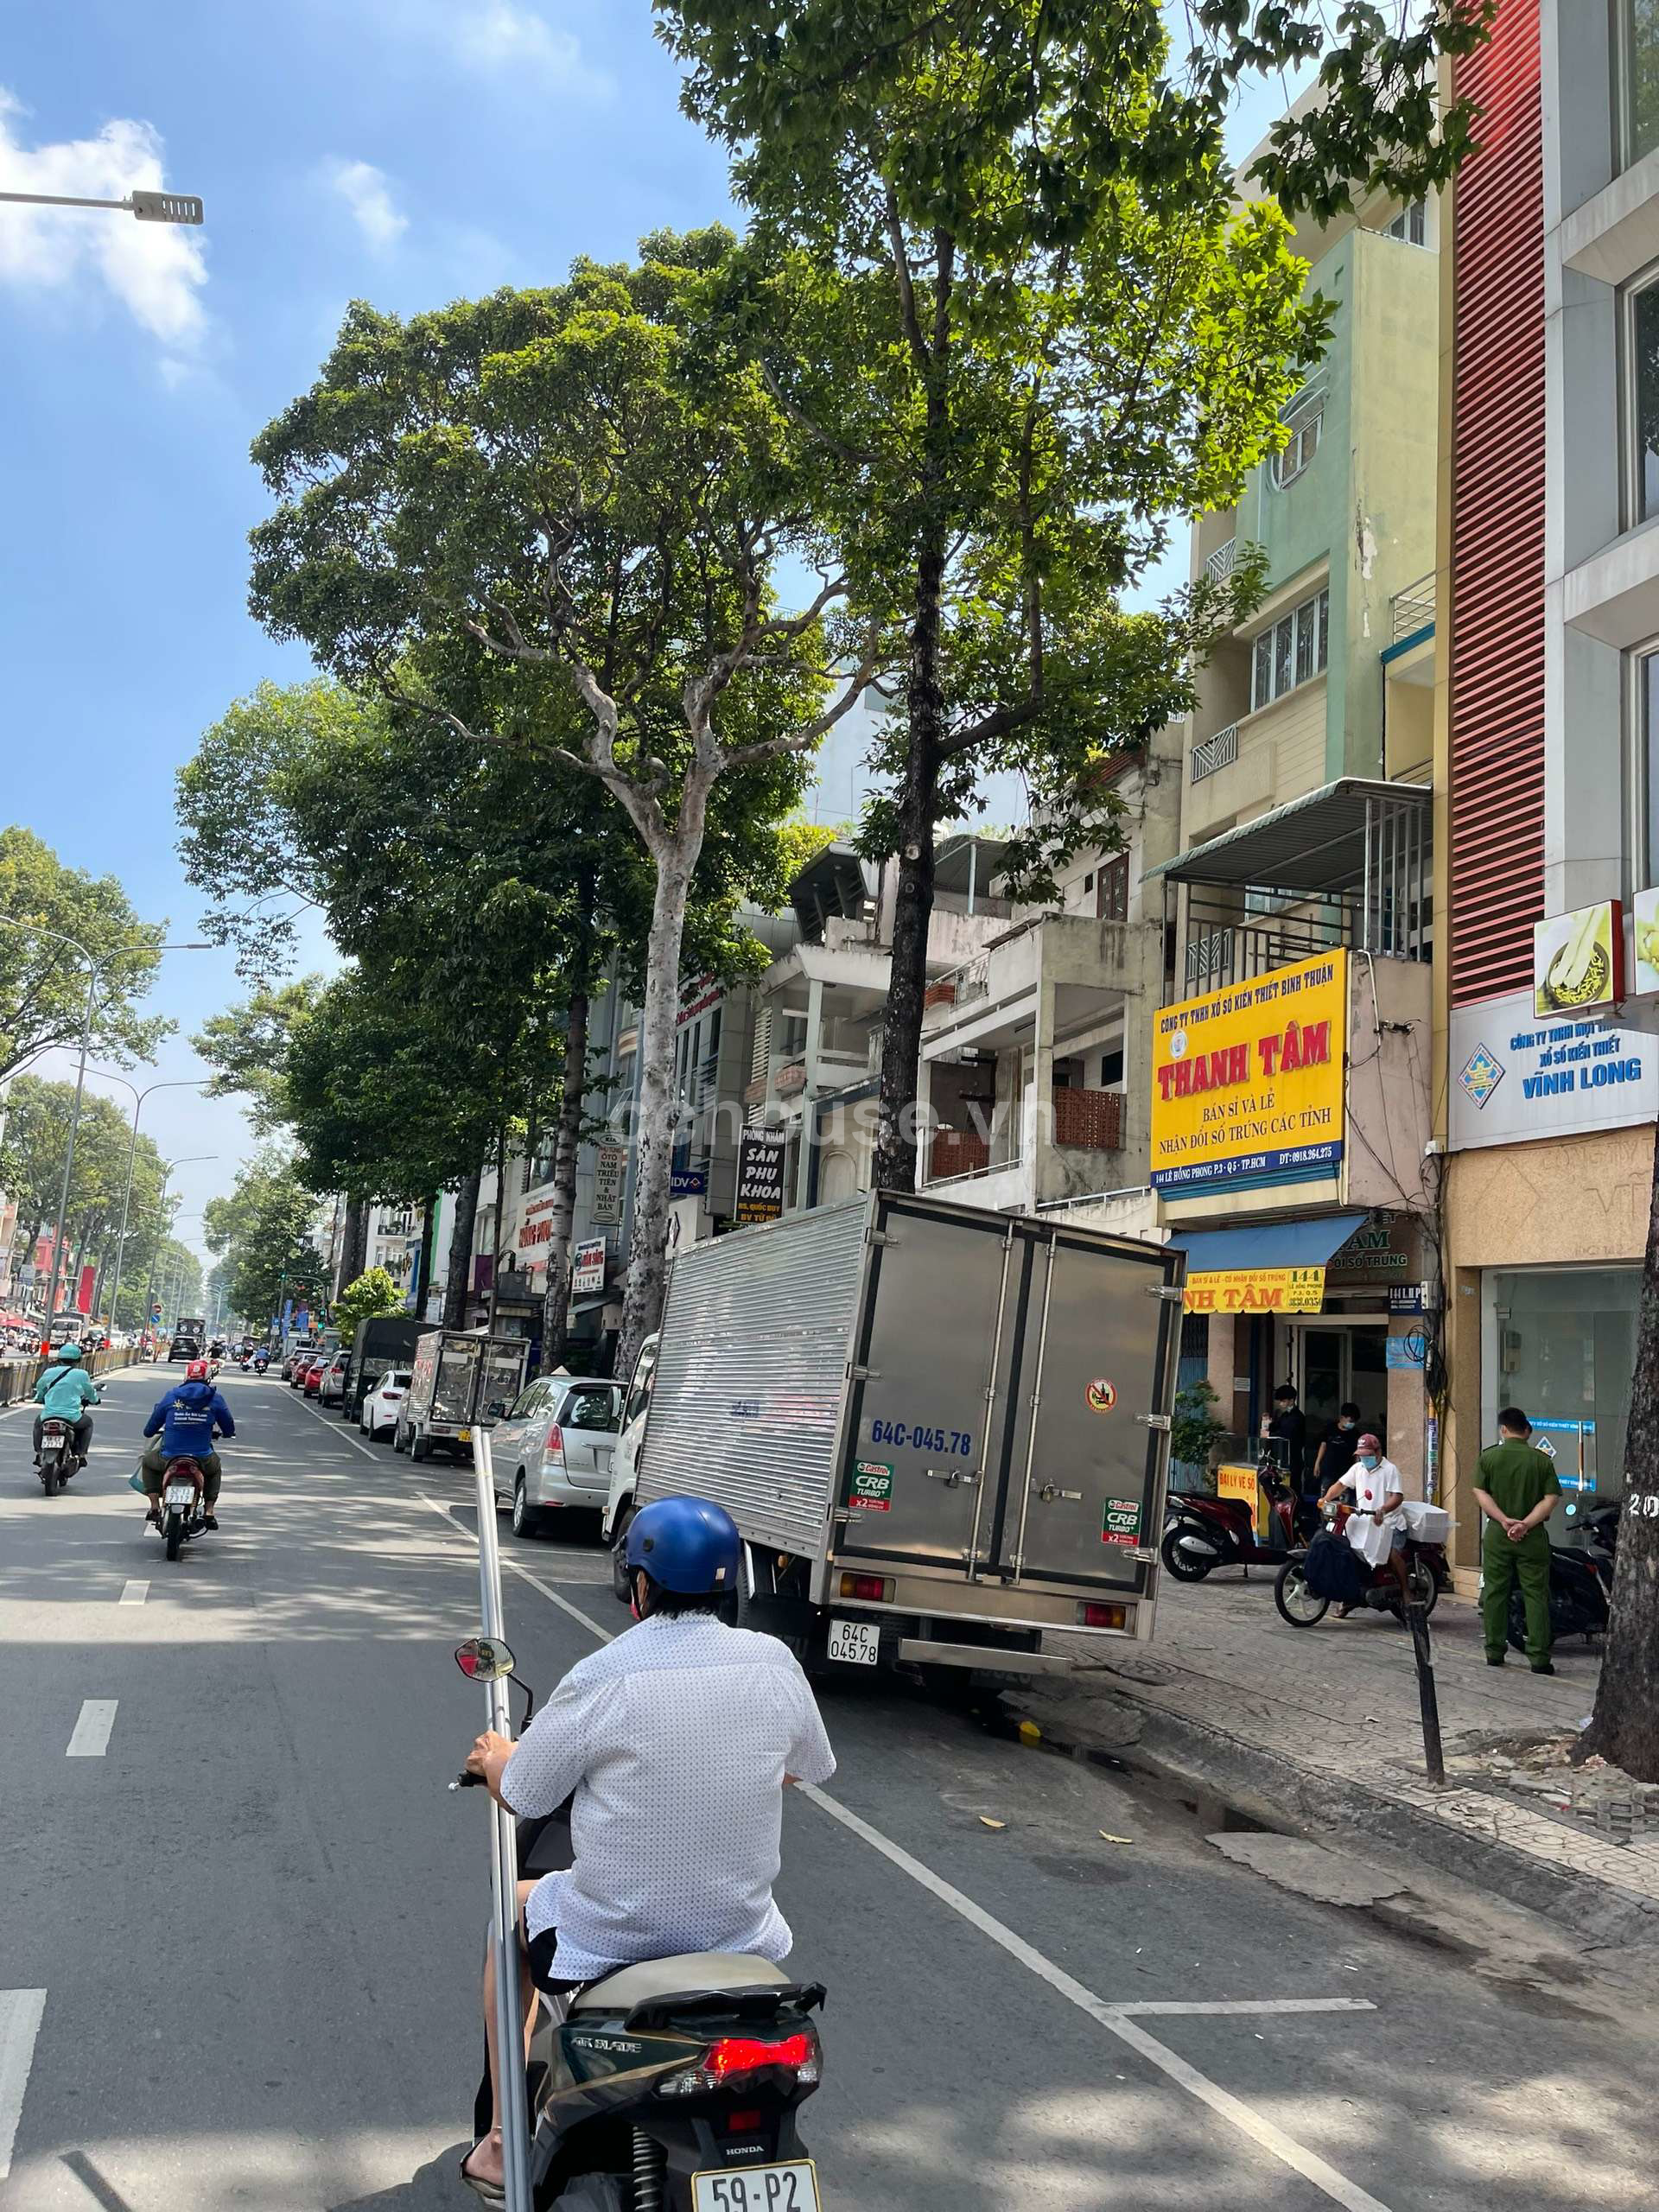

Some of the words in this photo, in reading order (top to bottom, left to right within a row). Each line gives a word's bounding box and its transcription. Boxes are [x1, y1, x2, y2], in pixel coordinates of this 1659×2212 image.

[1179, 1012, 1189, 1027] TY
[1191, 1005, 1209, 1025] TNHH
[1234, 986, 1252, 1011] KIẾN
[1255, 978, 1279, 1003] THIẾT
[1281, 975, 1301, 995] BÌNH
[1304, 963, 1333, 989] THUẬN
[1535, 1031, 1547, 1046] TY
[1548, 1024, 1573, 1043] TNHH
[1567, 1041, 1591, 1062] KIẾN
[1592, 1034, 1621, 1057] THIẾT
[1158, 1042, 1250, 1101] THANH
[1258, 1020, 1332, 1077] TÂM
[1523, 1071, 1574, 1099] VĨNH
[1580, 1058, 1642, 1090] LONG
[1203, 1102, 1225, 1122] BÁN
[1242, 1094, 1256, 1114] VÀ
[1160, 1134, 1187, 1155] NHẬN
[1211, 1122, 1225, 1144] SỐ
[1229, 1119, 1268, 1141] TRÚNG
[1271, 1112, 1296, 1134] CÁC
[746, 1145, 779, 1163] SẢN
[745, 1166, 778, 1183] PHỤ
[1192, 1166, 1213, 1179] PHONG
[1242, 1157, 1266, 1170] TP.HCM
[671, 1176, 690, 1188] IDV
[740, 1183, 781, 1199] KHOA
[1292, 1270, 1319, 1282] 144
[1223, 1284, 1284, 1309] TÂM
[871, 1419, 972, 1456] 64C-045.78
[856, 1475, 890, 1490] CRB
[1107, 1512, 1138, 1526] CRB
[842, 1623, 869, 1643] 64C
[830, 1641, 877, 1663] 045.78
[726, 2145, 765, 2156] HONDA
[712, 2171, 801, 2212] 59-P2
